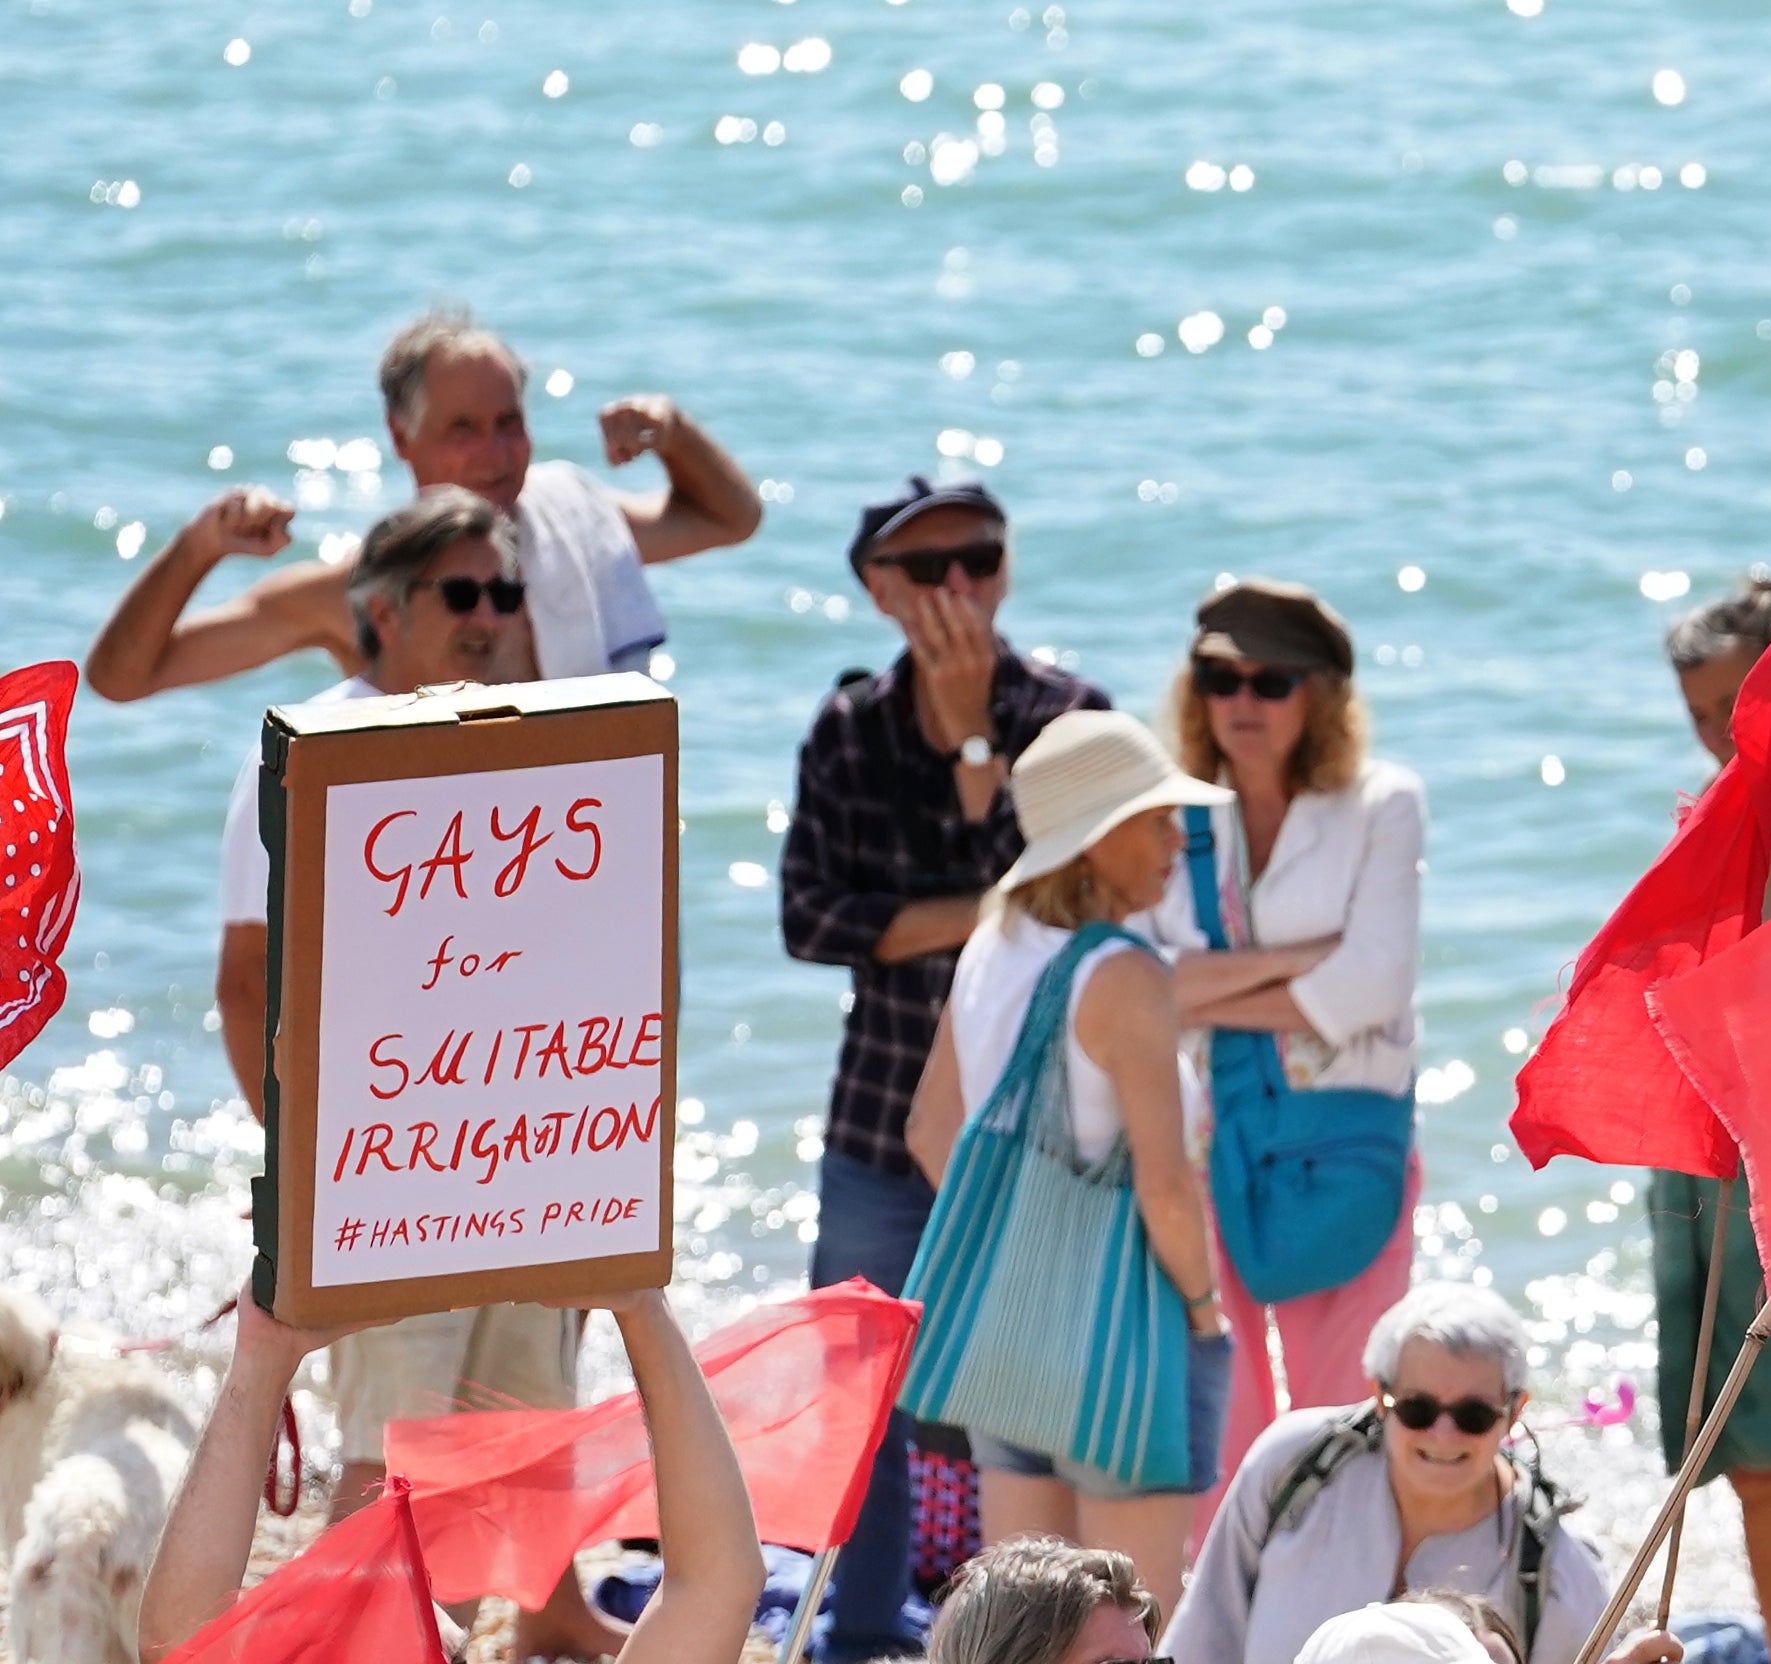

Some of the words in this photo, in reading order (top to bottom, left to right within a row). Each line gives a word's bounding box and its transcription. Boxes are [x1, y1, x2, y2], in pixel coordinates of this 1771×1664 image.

[363, 797, 604, 918] GAYS
[420, 934, 523, 991] for
[368, 1013, 662, 1100] SUITABLE
[334, 1209, 525, 1252] #HASTINGS
[541, 1197, 643, 1235] PRIDE
